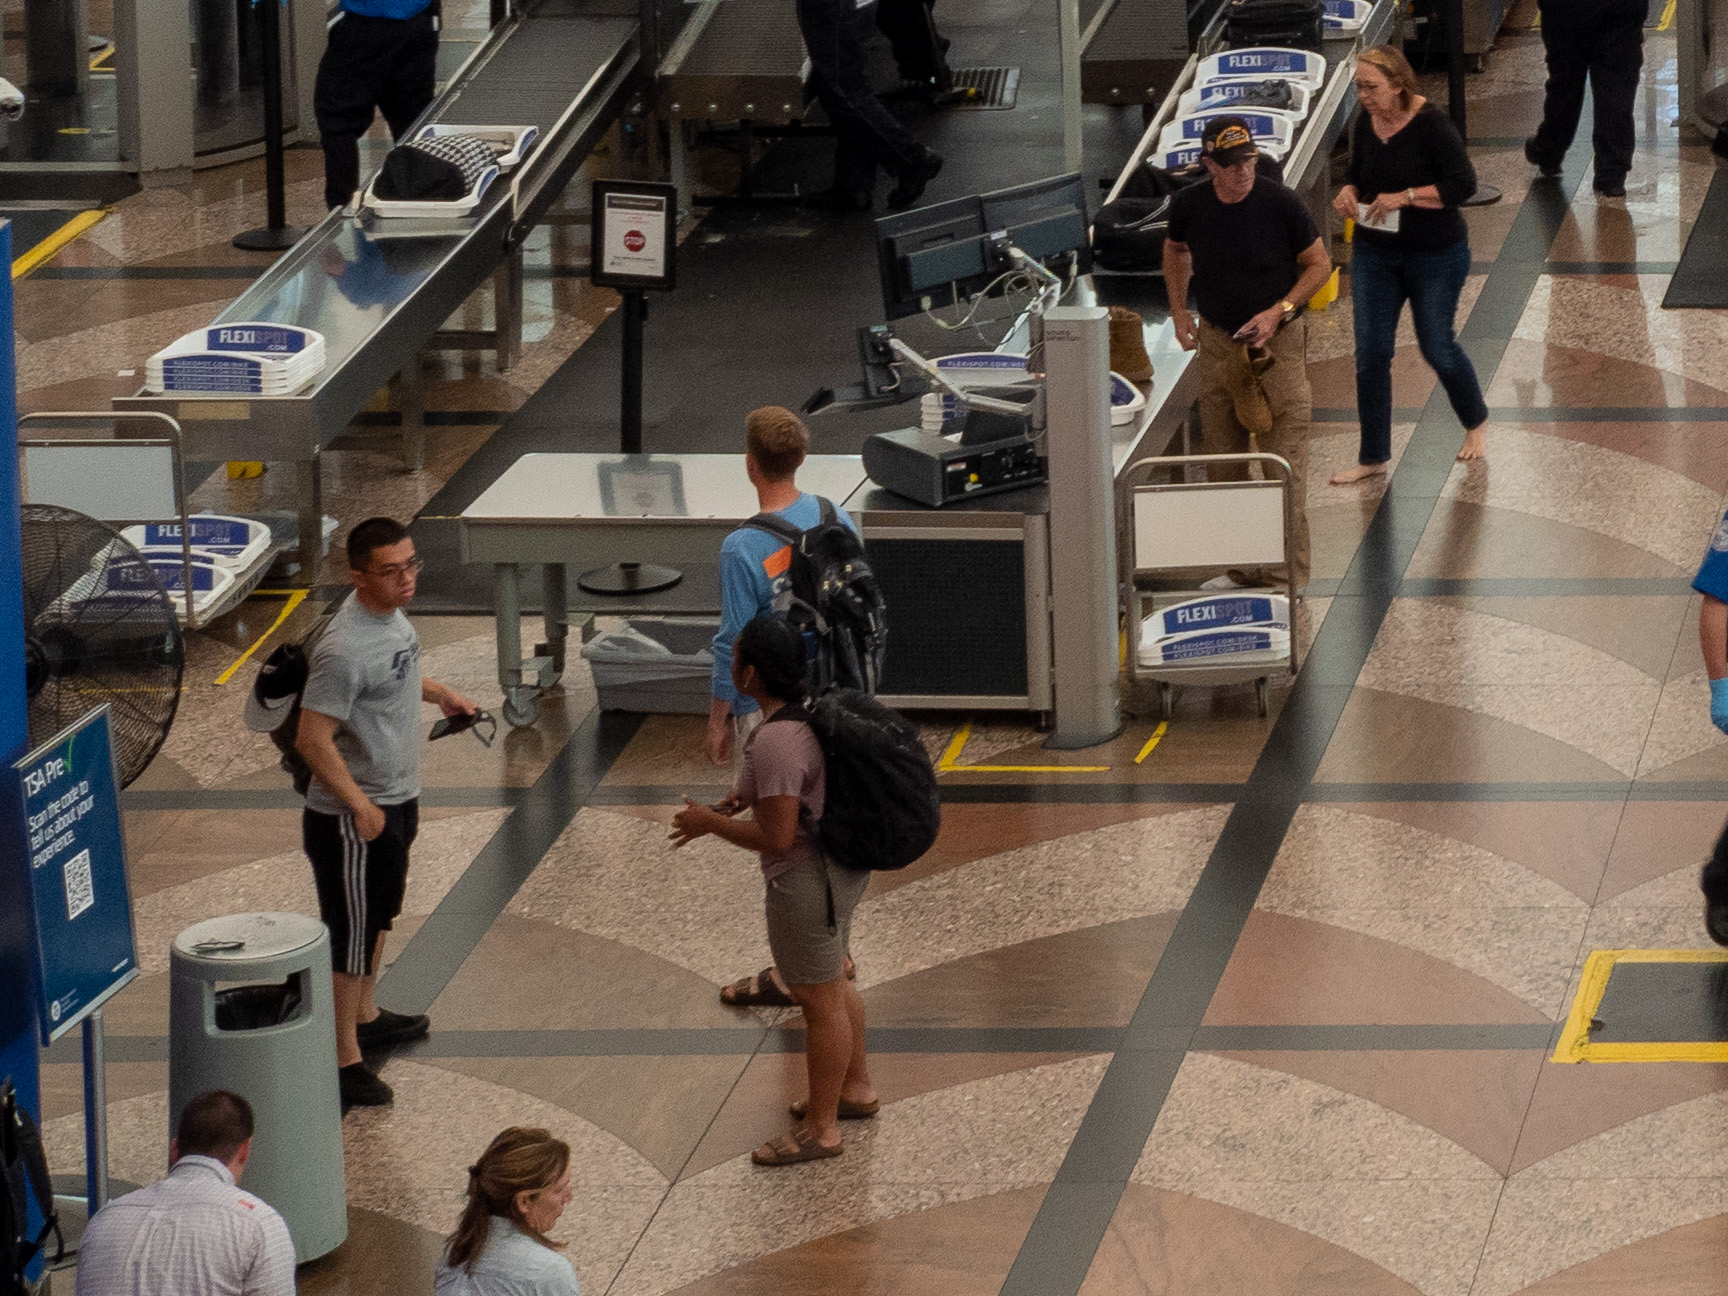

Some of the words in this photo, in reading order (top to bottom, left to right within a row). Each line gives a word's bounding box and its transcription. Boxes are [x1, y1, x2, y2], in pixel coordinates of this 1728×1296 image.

[1229, 54, 1291, 68] FLEXISPOT
[219, 330, 288, 344] FLEXISPOT
[209, 536, 231, 544] .COM
[1177, 600, 1252, 624] FLEXISPOT
[1230, 614, 1253, 624] .COM
[24, 768, 46, 798] TSA
[45, 757, 65, 785] Pre
[29, 808, 48, 833] Scan
[48, 799, 61, 817] the
[60, 786, 80, 809] code
[79, 780, 89, 796] to
[30, 828, 43, 851] tell
[44, 825, 55, 841] us
[54, 808, 78, 833] about
[77, 794, 94, 821] your
